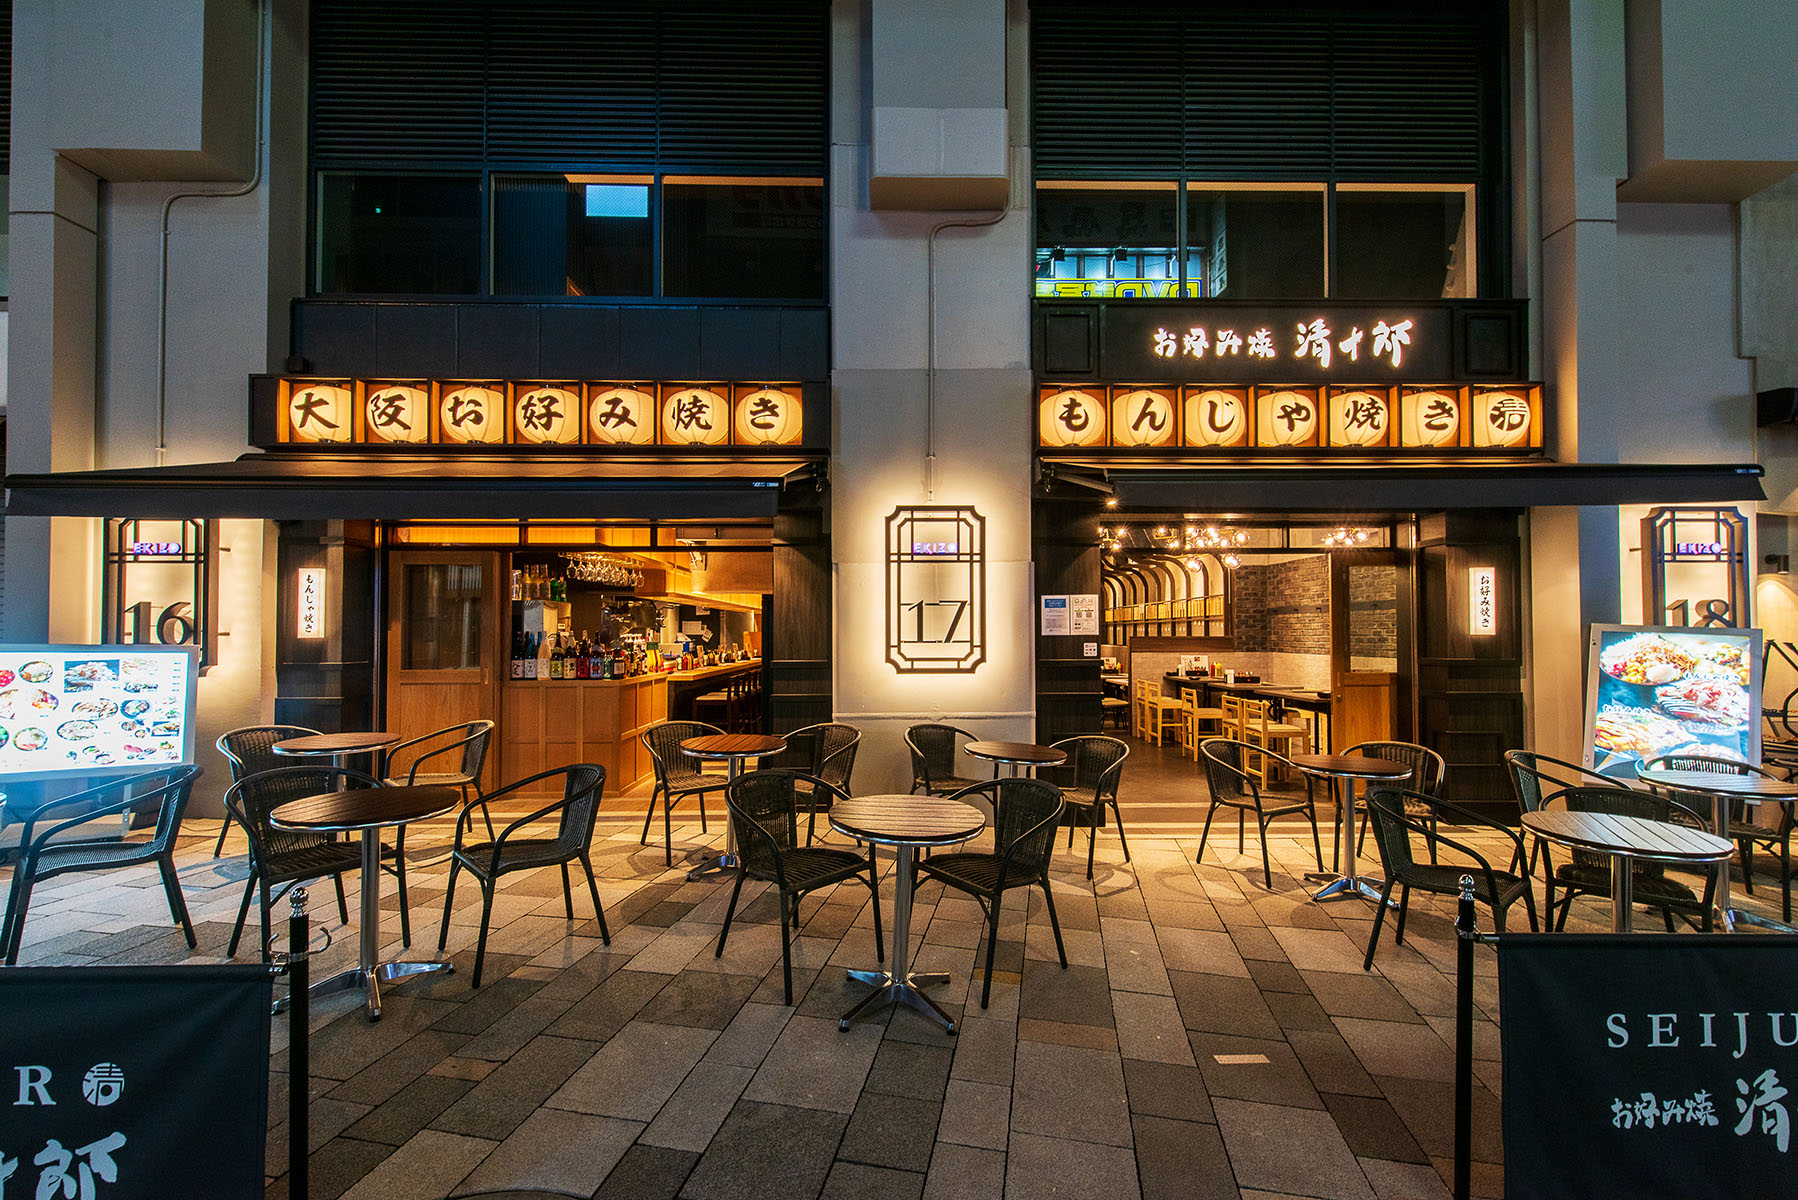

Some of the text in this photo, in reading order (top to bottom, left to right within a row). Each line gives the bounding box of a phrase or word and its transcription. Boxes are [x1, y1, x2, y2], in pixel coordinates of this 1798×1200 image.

[1153, 318, 1414, 368] お好み焼 清十郎
[294, 391, 780, 432] 大阪お好み焼き
[913, 542, 958, 555] EKIZO
[1677, 542, 1722, 555] EKIZO
[123, 601, 194, 645] 16
[907, 600, 968, 643] 17
[1606, 1012, 1798, 1058] SEIJU
[13, 1065, 57, 1105] R
[1611, 1089, 1719, 1129] お好み焼
